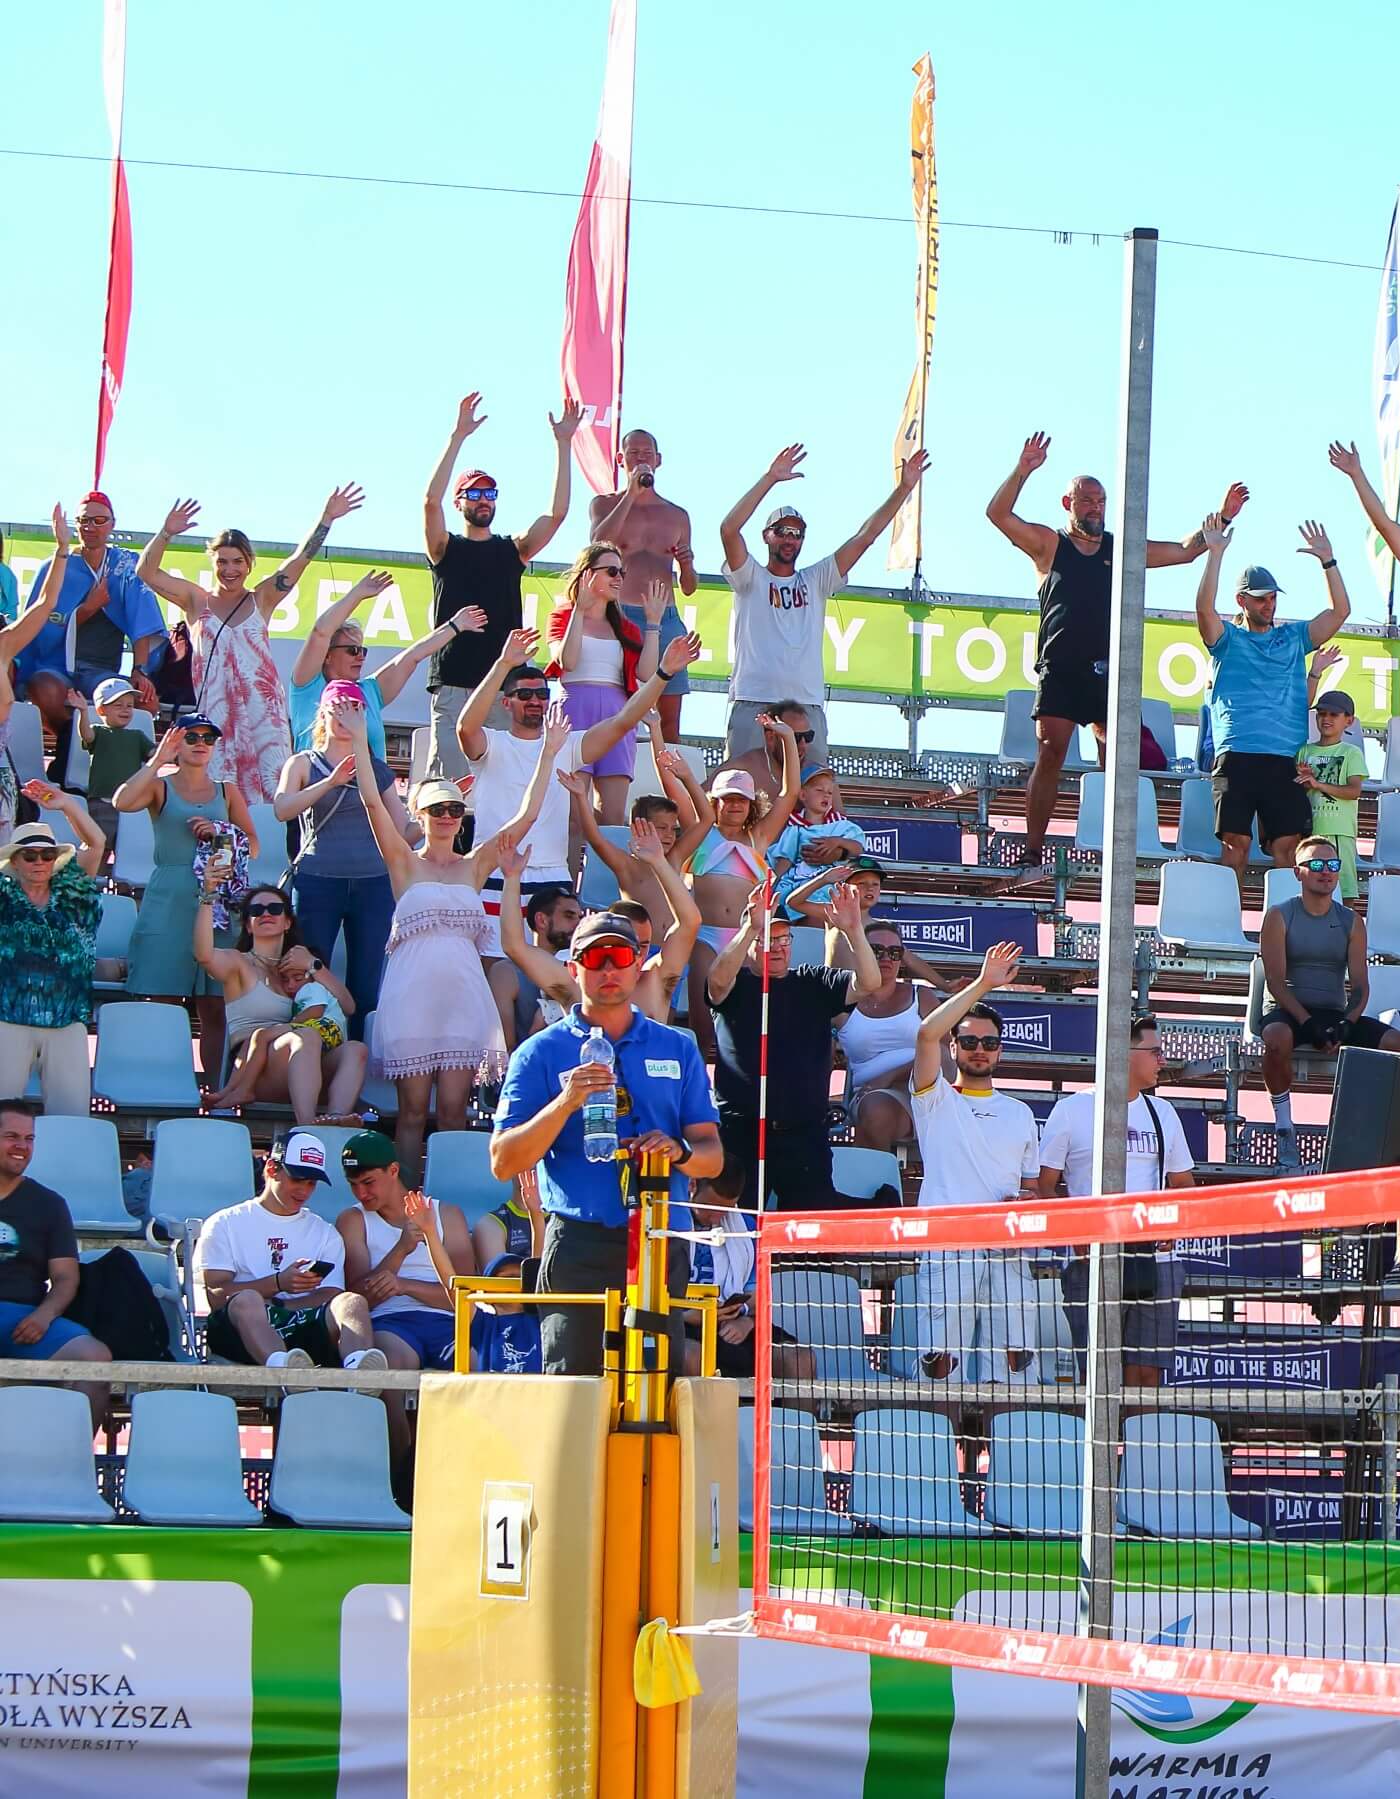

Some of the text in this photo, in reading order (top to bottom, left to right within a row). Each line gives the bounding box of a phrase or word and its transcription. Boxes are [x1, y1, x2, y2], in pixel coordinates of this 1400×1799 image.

[866, 836, 891, 854] ACH
[902, 926, 965, 944] HE BEACH
[1290, 1191, 1326, 1213] ORLEN
[1174, 1356, 1320, 1382] PLAY ON THE BEACH
[1275, 1498, 1311, 1521] PLAY
[1318, 1502, 1339, 1518] ON
[497, 1516, 514, 1570] 1
[60, 1702, 193, 1730] WYŻSZA
[20, 1737, 139, 1753] UNIVERSITY
[1109, 1752, 1272, 1779] WARMIA
